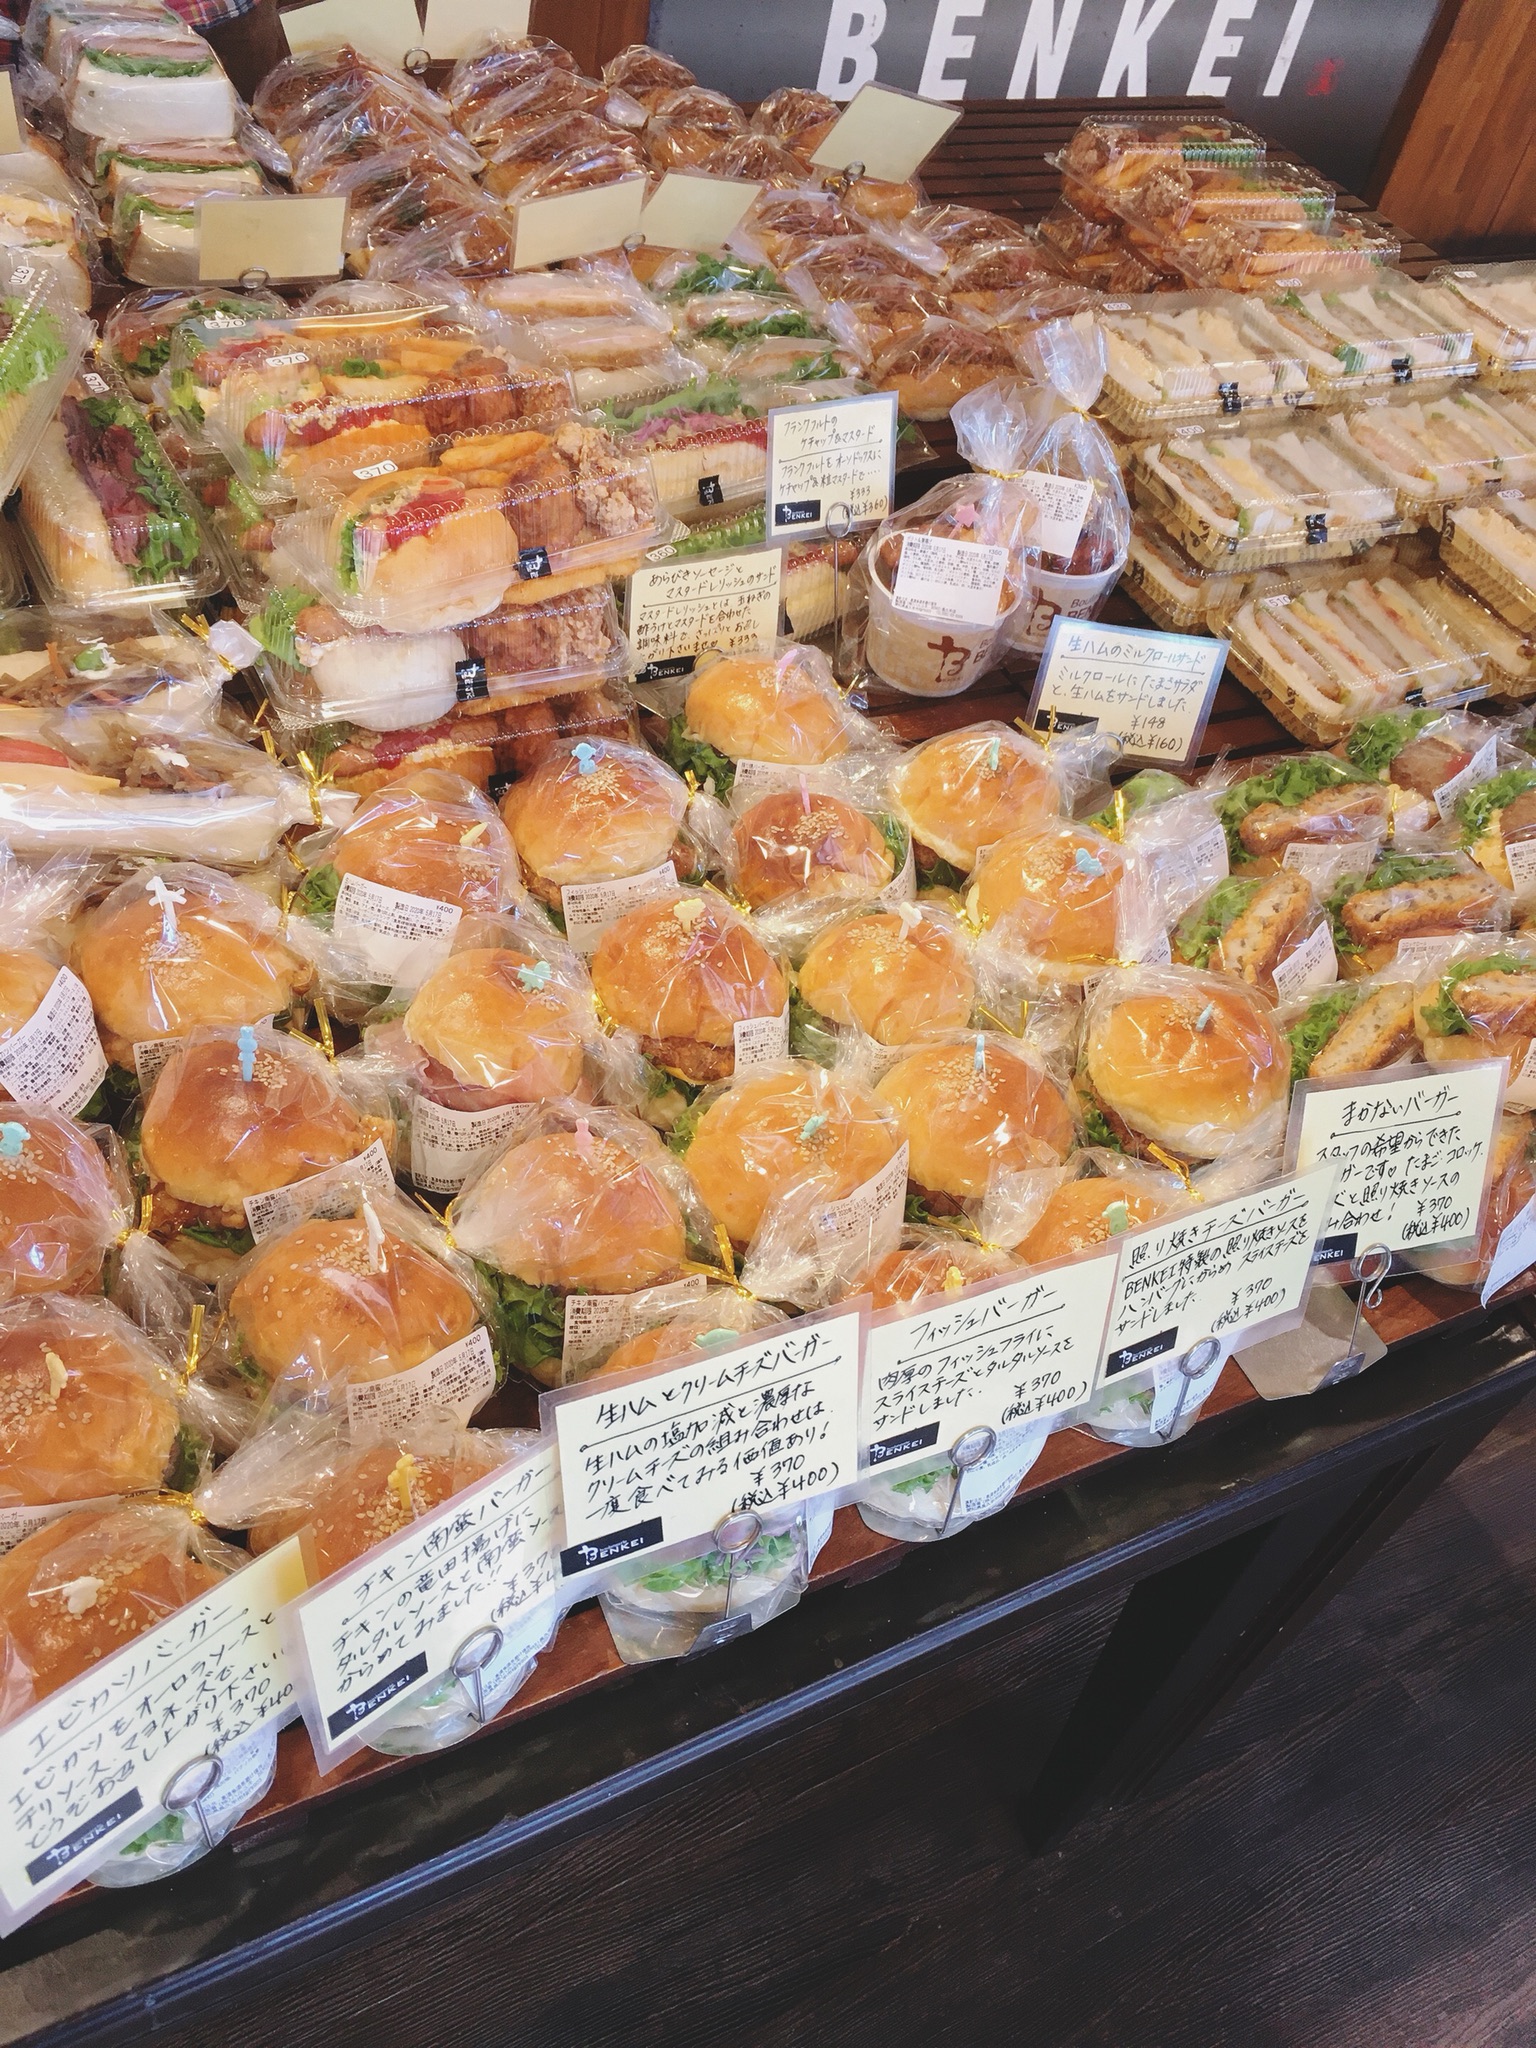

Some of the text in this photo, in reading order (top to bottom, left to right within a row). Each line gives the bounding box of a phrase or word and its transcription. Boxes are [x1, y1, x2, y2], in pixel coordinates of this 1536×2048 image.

[815, 0, 1312, 100] BENKEI
[210, 319, 245, 329] 370
[271, 355, 308, 366] 370
[784, 414, 838, 436] フランクフルトの
[360, 462, 397, 479] 370
[850, 486, 871, 500] ¥333
[649, 546, 675, 561] 360
[729, 632, 758, 649] ¥333
[1068, 635, 1206, 671] 生ハムのミルクロールサンド
[647, 663, 685, 680] BENKEI
[1131, 714, 1166, 730] ¥148
[659, 865, 671, 875] ¥400
[436, 905, 454, 914] ¥400
[1341, 1085, 1459, 1126] まかないバーガー
[363, 1146, 378, 1161] ¥400
[1417, 1196, 1453, 1215] ¥370
[1128, 1188, 1306, 1270] 照り焼きチーズバーガー
[1401, 1207, 1471, 1241] (税込¥400)
[684, 1278, 700, 1288] ¥400
[1231, 1277, 1273, 1305] ¥370
[910, 1284, 1058, 1350] フィッシュバーガー
[1210, 1289, 1286, 1333] (税込¥400)
[465, 1334, 481, 1348] ¥400
[878, 1325, 1054, 1391] 肉厚のフィッシュフライに
[1118, 1344, 1164, 1368] BENKEI
[1014, 1370, 1062, 1399] ¥370
[1001, 1381, 1088, 1424] (税込¥400)
[585, 1381, 816, 1473] 生ハムの塩加減と濃厚な
[870, 1439, 923, 1463] BENKEI
[750, 1454, 806, 1486] ¥370
[731, 1461, 839, 1513] (税込¥400)
[353, 1463, 551, 1606] チキン南蛮バーガー
[578, 1537, 644, 1566] BENKEI
[332, 1505, 533, 1657] チキンの竜田揚げに
[28, 1604, 233, 1759] エビカツバーガー
[207, 1678, 271, 1733] ¥370
[346, 1675, 411, 1721] BENKEI
[46, 1812, 122, 1867] BENKEI
